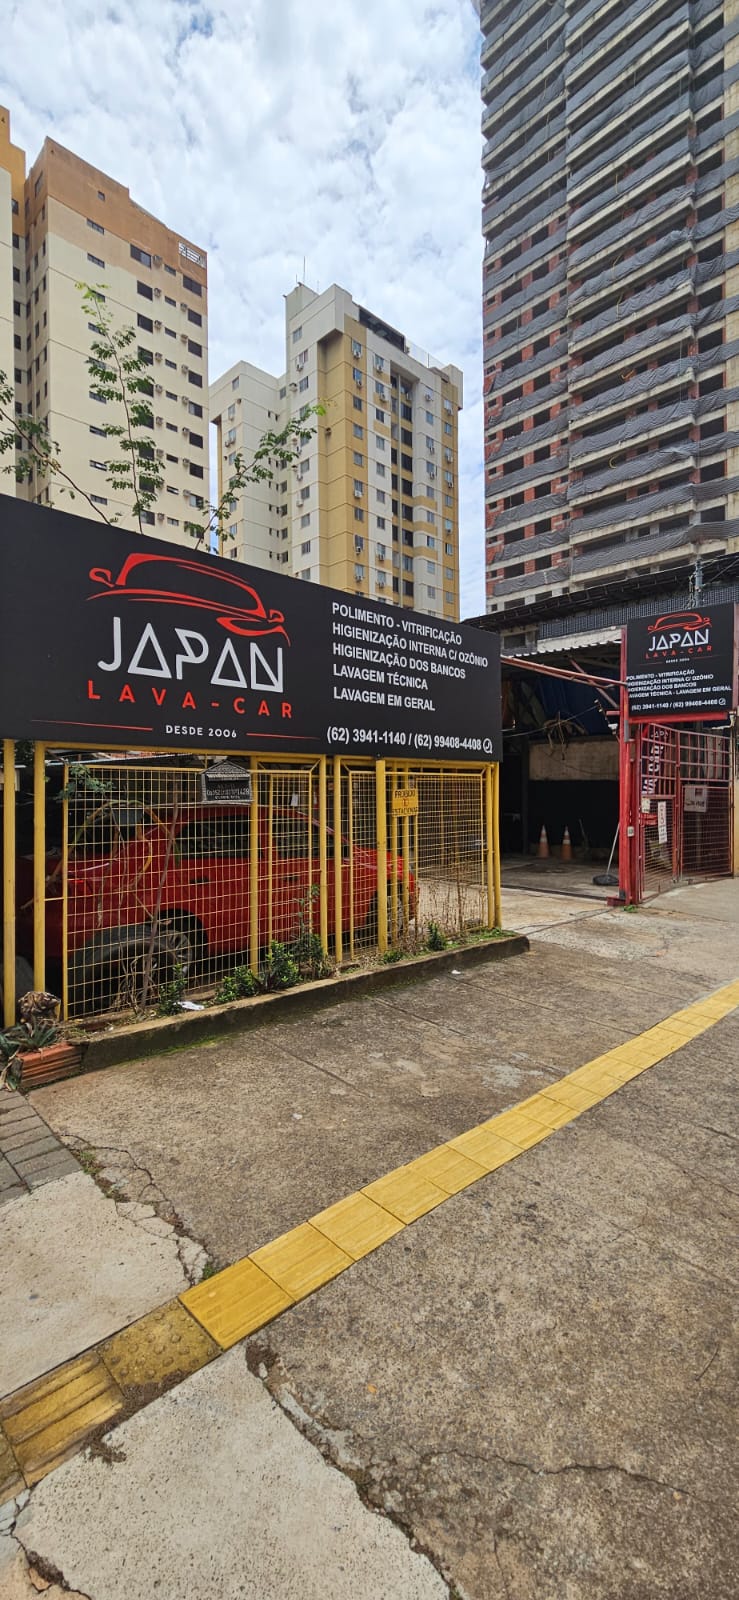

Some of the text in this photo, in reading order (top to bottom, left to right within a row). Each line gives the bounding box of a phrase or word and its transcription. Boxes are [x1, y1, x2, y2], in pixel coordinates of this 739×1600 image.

[332, 602, 394, 628] POLIMENTO
[402, 620, 462, 645] VITRIFICAÇÃO
[332, 622, 488, 668] HIGIENIZAÇÃO INTERNA C/ OZÔNIO
[645, 645, 712, 659] LAVA-CAR
[648, 628, 709, 652] JAPAN
[97, 616, 284, 693] JAPAN
[332, 642, 466, 679] HIGIENIZAÇÃO DOS BANCOS
[333, 663, 428, 690] LAVAGEM TÉCNICA
[87, 679, 292, 719] LAVA-CAR
[333, 686, 436, 711] LAVAGEM EM GERAL
[165, 724, 237, 738] DESDE 2006
[327, 726, 350, 744] (62)
[352, 728, 406, 745] 3941-1140
[414, 733, 432, 750] (62)
[434, 735, 481, 750] 99408-4408
